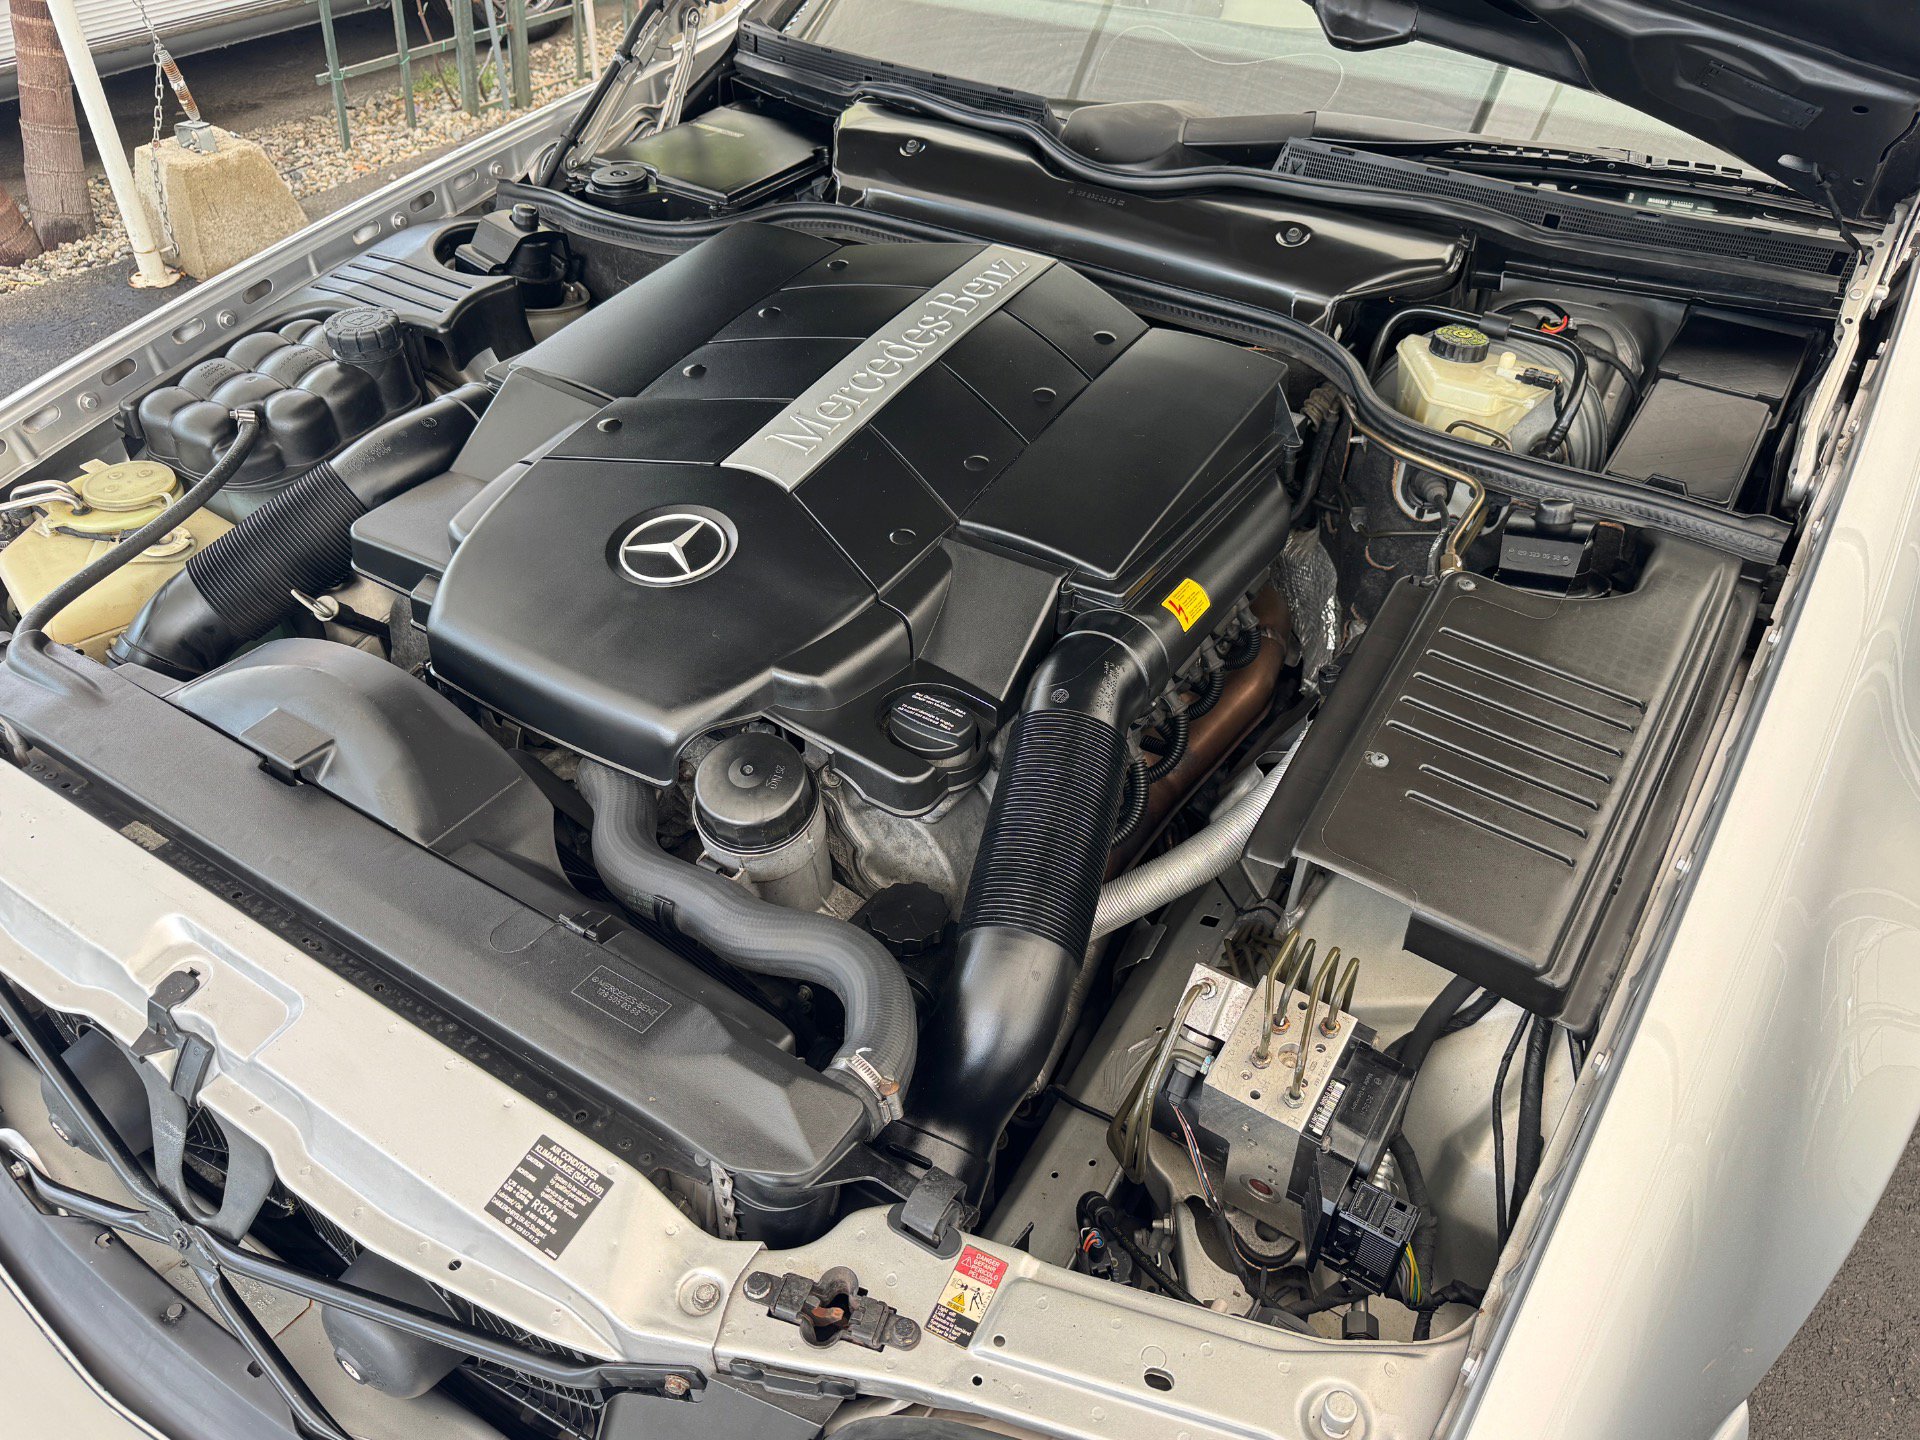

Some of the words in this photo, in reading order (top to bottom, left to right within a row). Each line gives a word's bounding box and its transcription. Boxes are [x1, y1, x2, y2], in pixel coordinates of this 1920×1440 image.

[765, 257, 1031, 456] Mercedes-Benz
[597, 980, 658, 1016] MERCEDES-BENZ
[535, 1144, 575, 1175] KLIMAANLAGE
[572, 1171, 588, 1184] (SAE
[588, 1182, 604, 1195] 639)
[550, 1144, 562, 1155] AIR
[560, 1151, 599, 1180] CONDITIONER
[530, 1198, 560, 1223] R134a
[971, 1265, 999, 1280] PERICOLO
[973, 1259, 996, 1273] GEFAHR
[976, 1254, 1000, 1267] DANGER
[968, 1270, 992, 1285] PELIGRO
